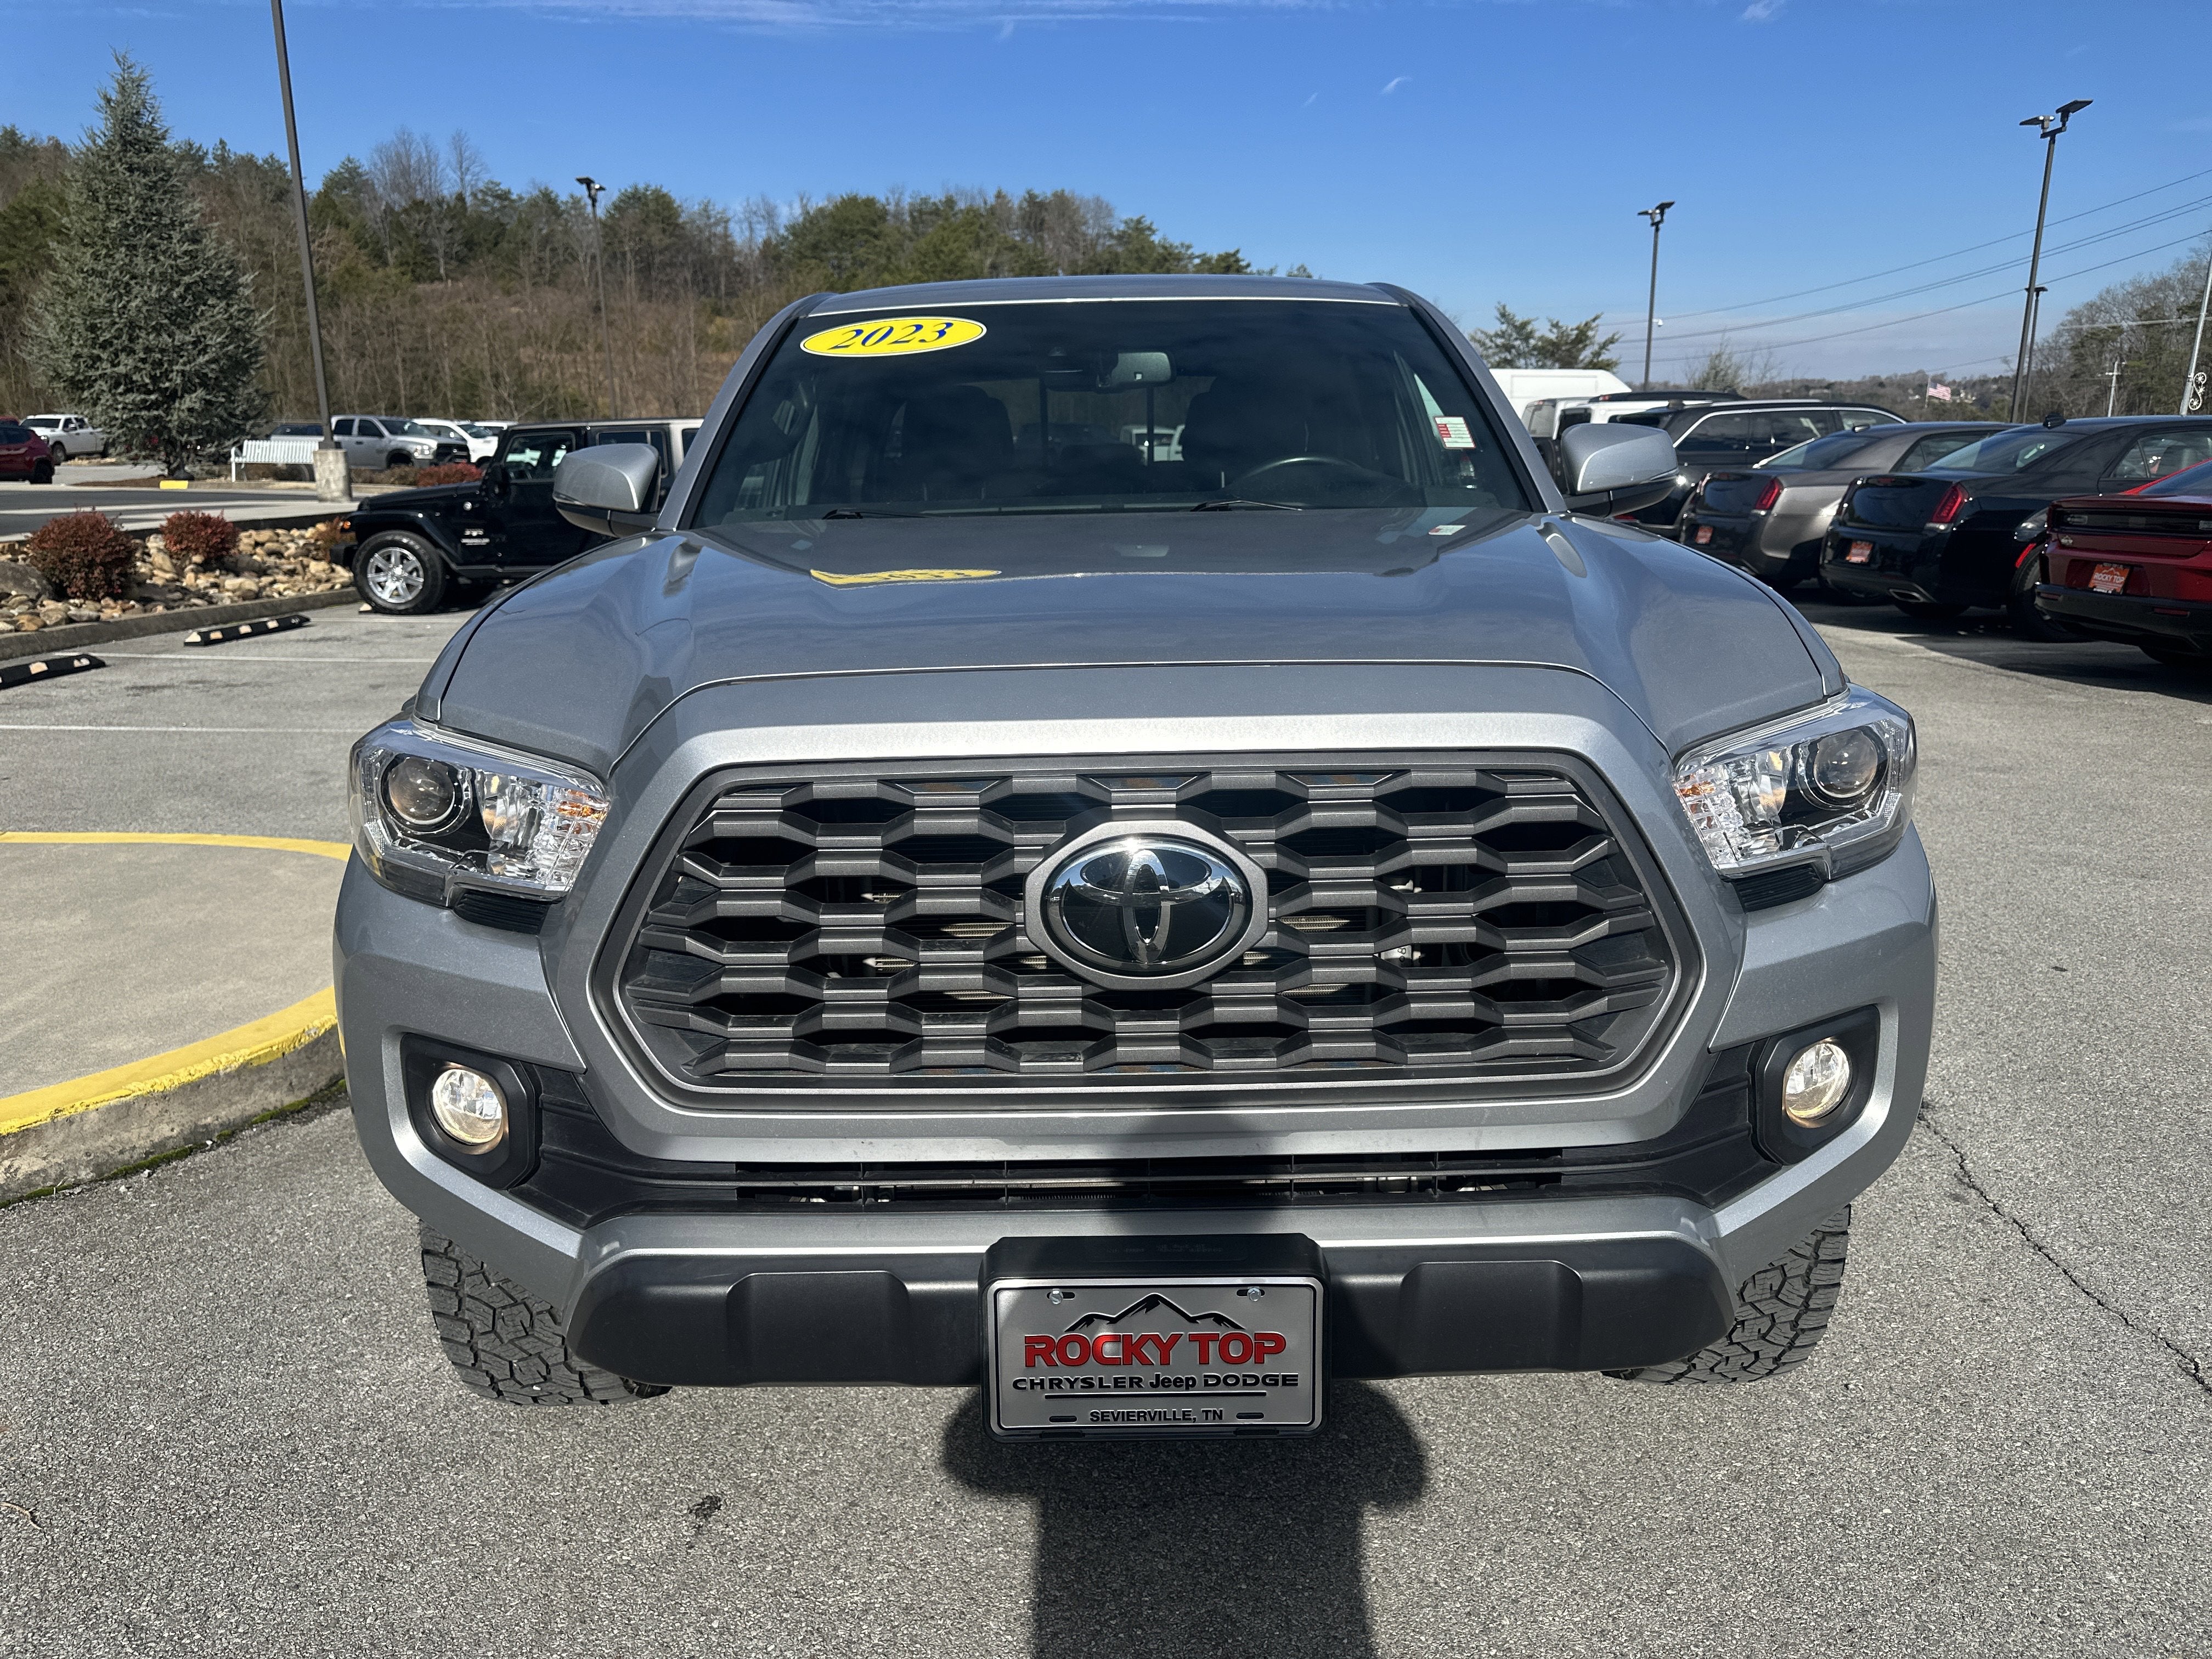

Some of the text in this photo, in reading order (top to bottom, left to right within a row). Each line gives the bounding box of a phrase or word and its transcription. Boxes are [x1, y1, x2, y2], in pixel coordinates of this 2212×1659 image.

[827, 322, 953, 350] 2023
[1024, 1332, 1286, 1367] ROCKY TOP
[1012, 1373, 1299, 1390] CHRYSLER Jeep DODGE
[1090, 1409, 1223, 1423] SEVIERVILLE, TN
